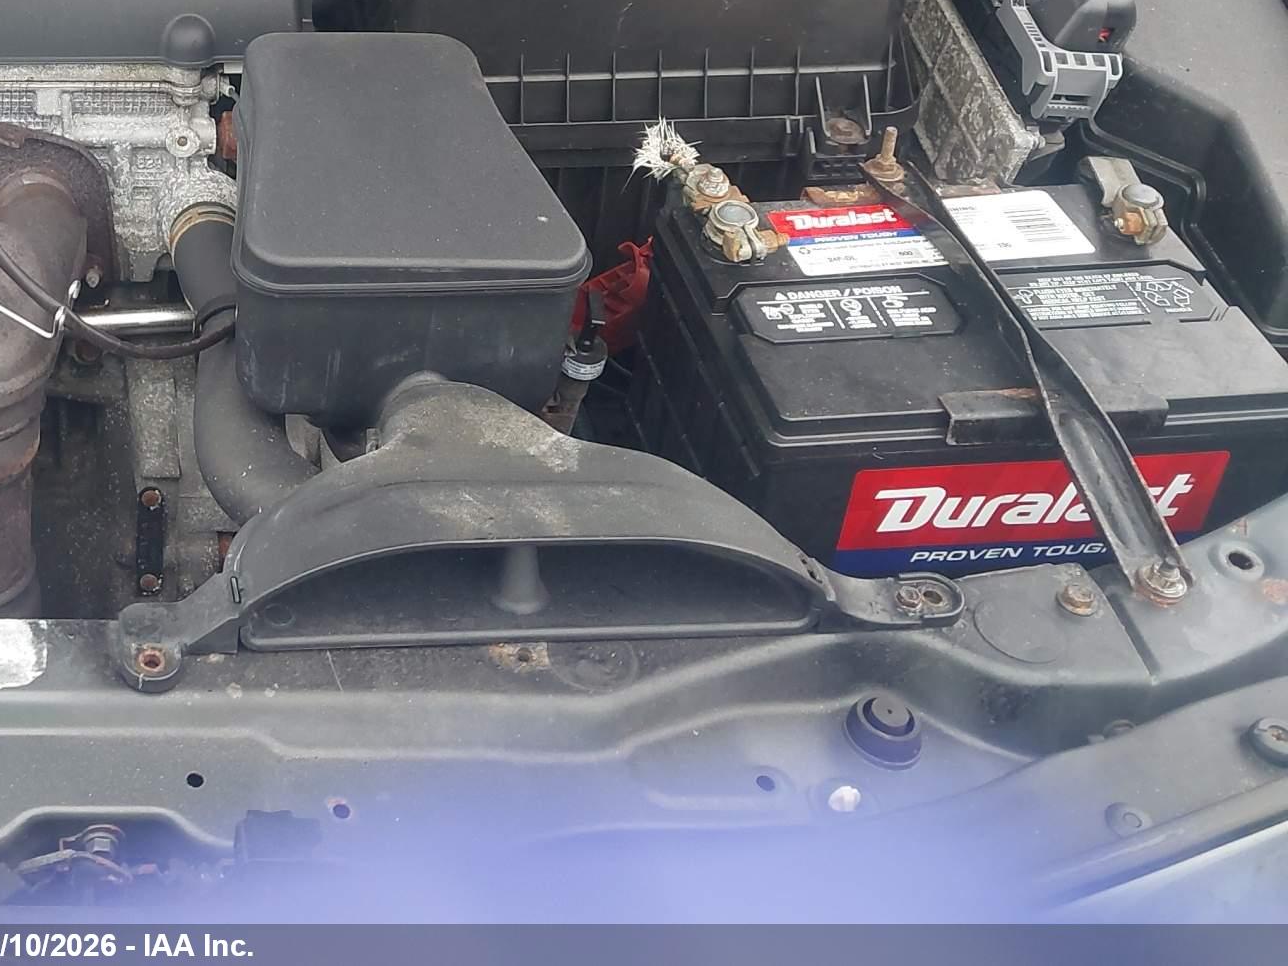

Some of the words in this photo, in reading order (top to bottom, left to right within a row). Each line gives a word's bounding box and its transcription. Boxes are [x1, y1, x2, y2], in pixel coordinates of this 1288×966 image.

[786, 208, 897, 231] Duralast
[814, 234, 859, 244] PROVEN
[860, 231, 898, 240] TOUGH
[787, 288, 842, 300] DANGER
[854, 285, 903, 296] POISON
[874, 473, 1195, 533] Duralt
[910, 547, 1023, 563] PROVEN
[1032, 543, 1108, 559] TOUG
